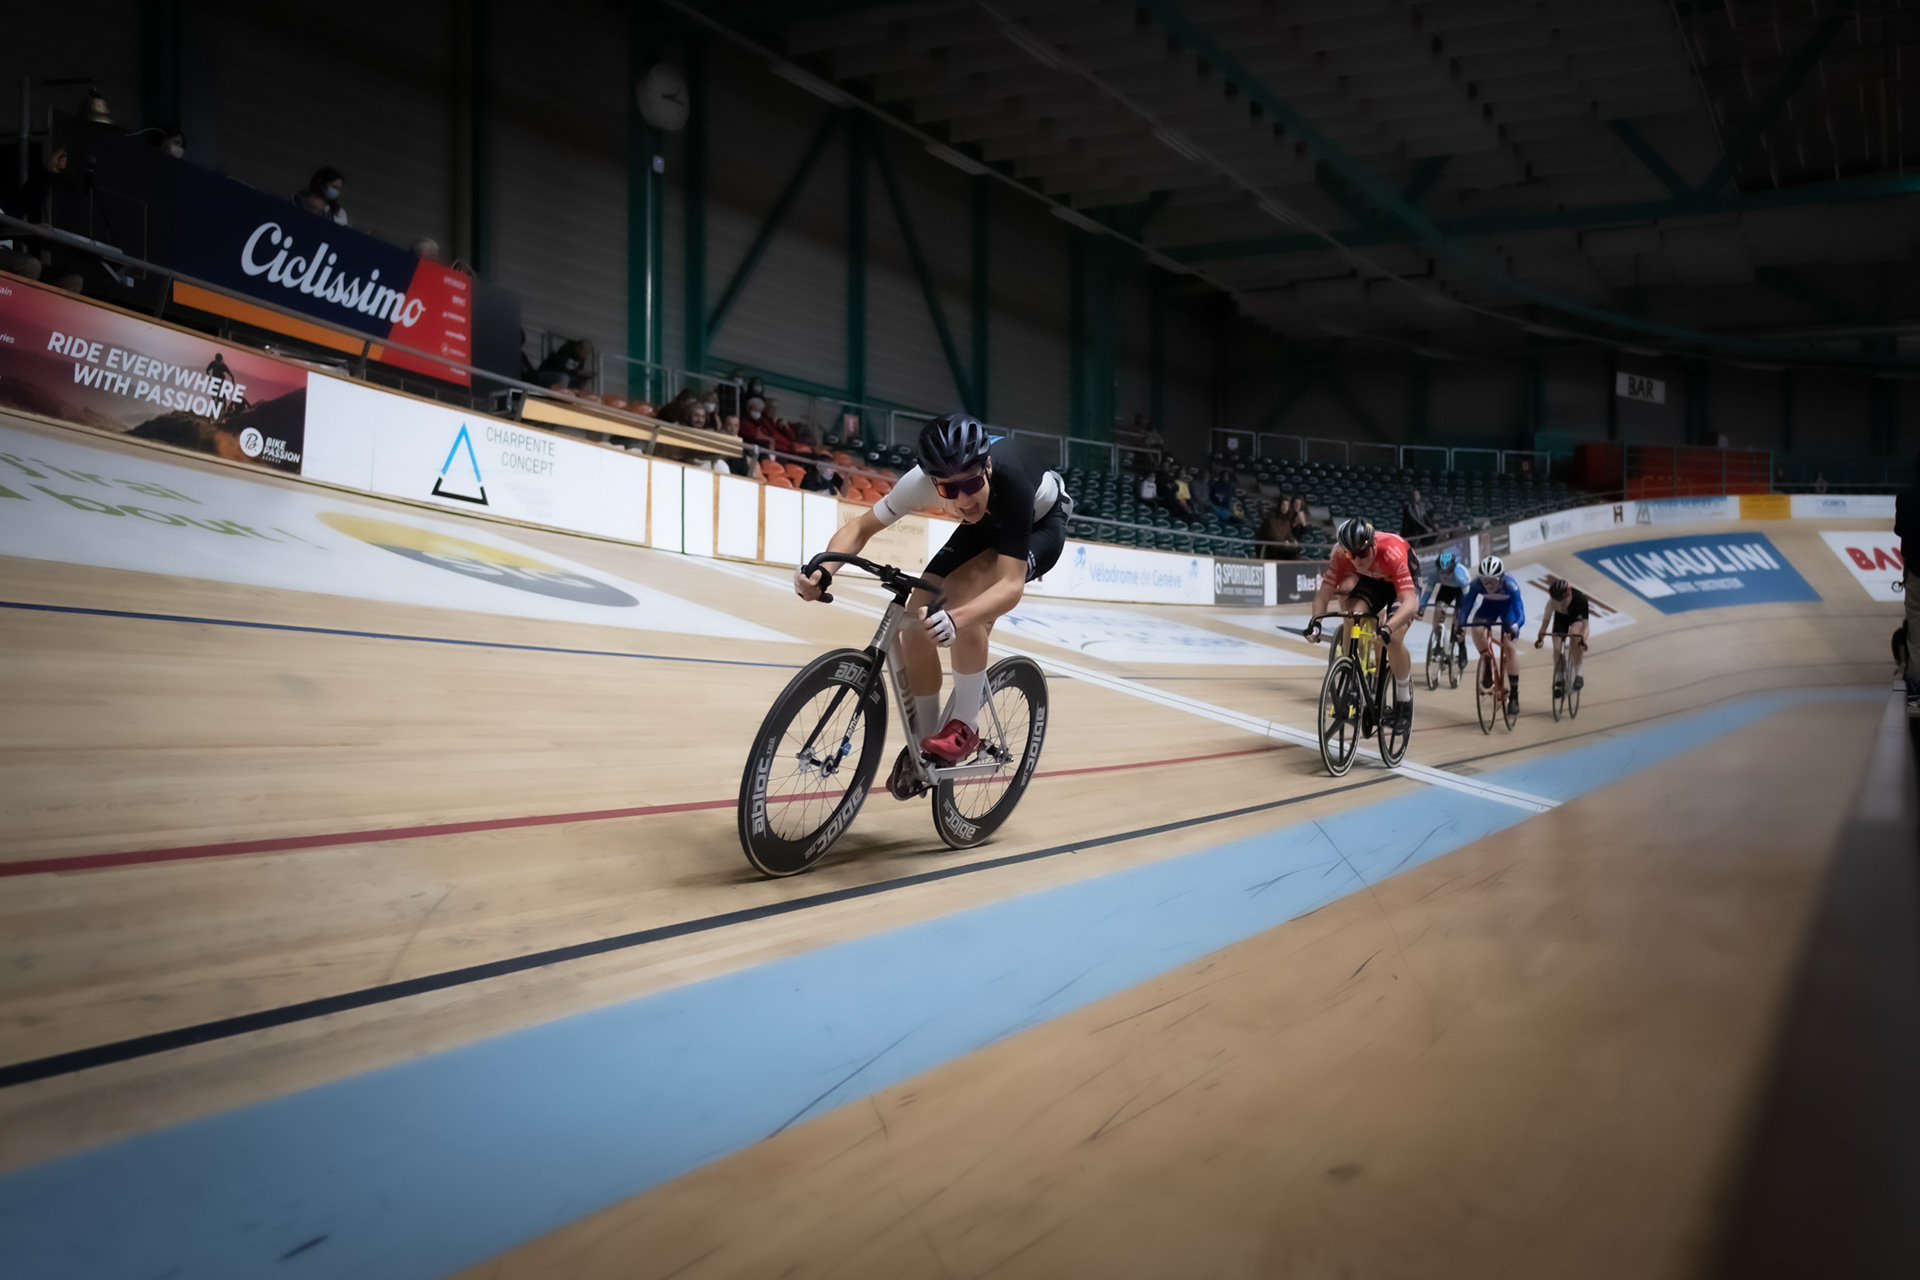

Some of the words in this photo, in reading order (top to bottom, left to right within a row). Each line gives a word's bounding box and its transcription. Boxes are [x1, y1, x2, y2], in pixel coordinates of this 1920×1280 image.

[241, 221, 426, 328] Ciclissimo
[47, 331, 104, 363] RIDE
[105, 347, 247, 404] EVERYWHERE
[74, 363, 131, 396] WITH
[134, 381, 224, 420] PASSION
[1628, 375, 1654, 400] BAR
[263, 446, 301, 463] PASSION
[265, 436, 287, 450] BIKE
[486, 426, 556, 457] CHARPENTE
[501, 451, 555, 476] CONCEPT
[1089, 563, 1139, 585] Vélodrome
[1139, 571, 1151, 586] de
[1152, 571, 1182, 588] Genève
[1222, 563, 1264, 586] SPORTQUEST
[1635, 543, 1780, 579] MAULINI
[1296, 574, 1316, 592] Bikes
[1026, 706, 1046, 772] abloc
[751, 757, 770, 838] abloc
[817, 785, 865, 853] abloc
